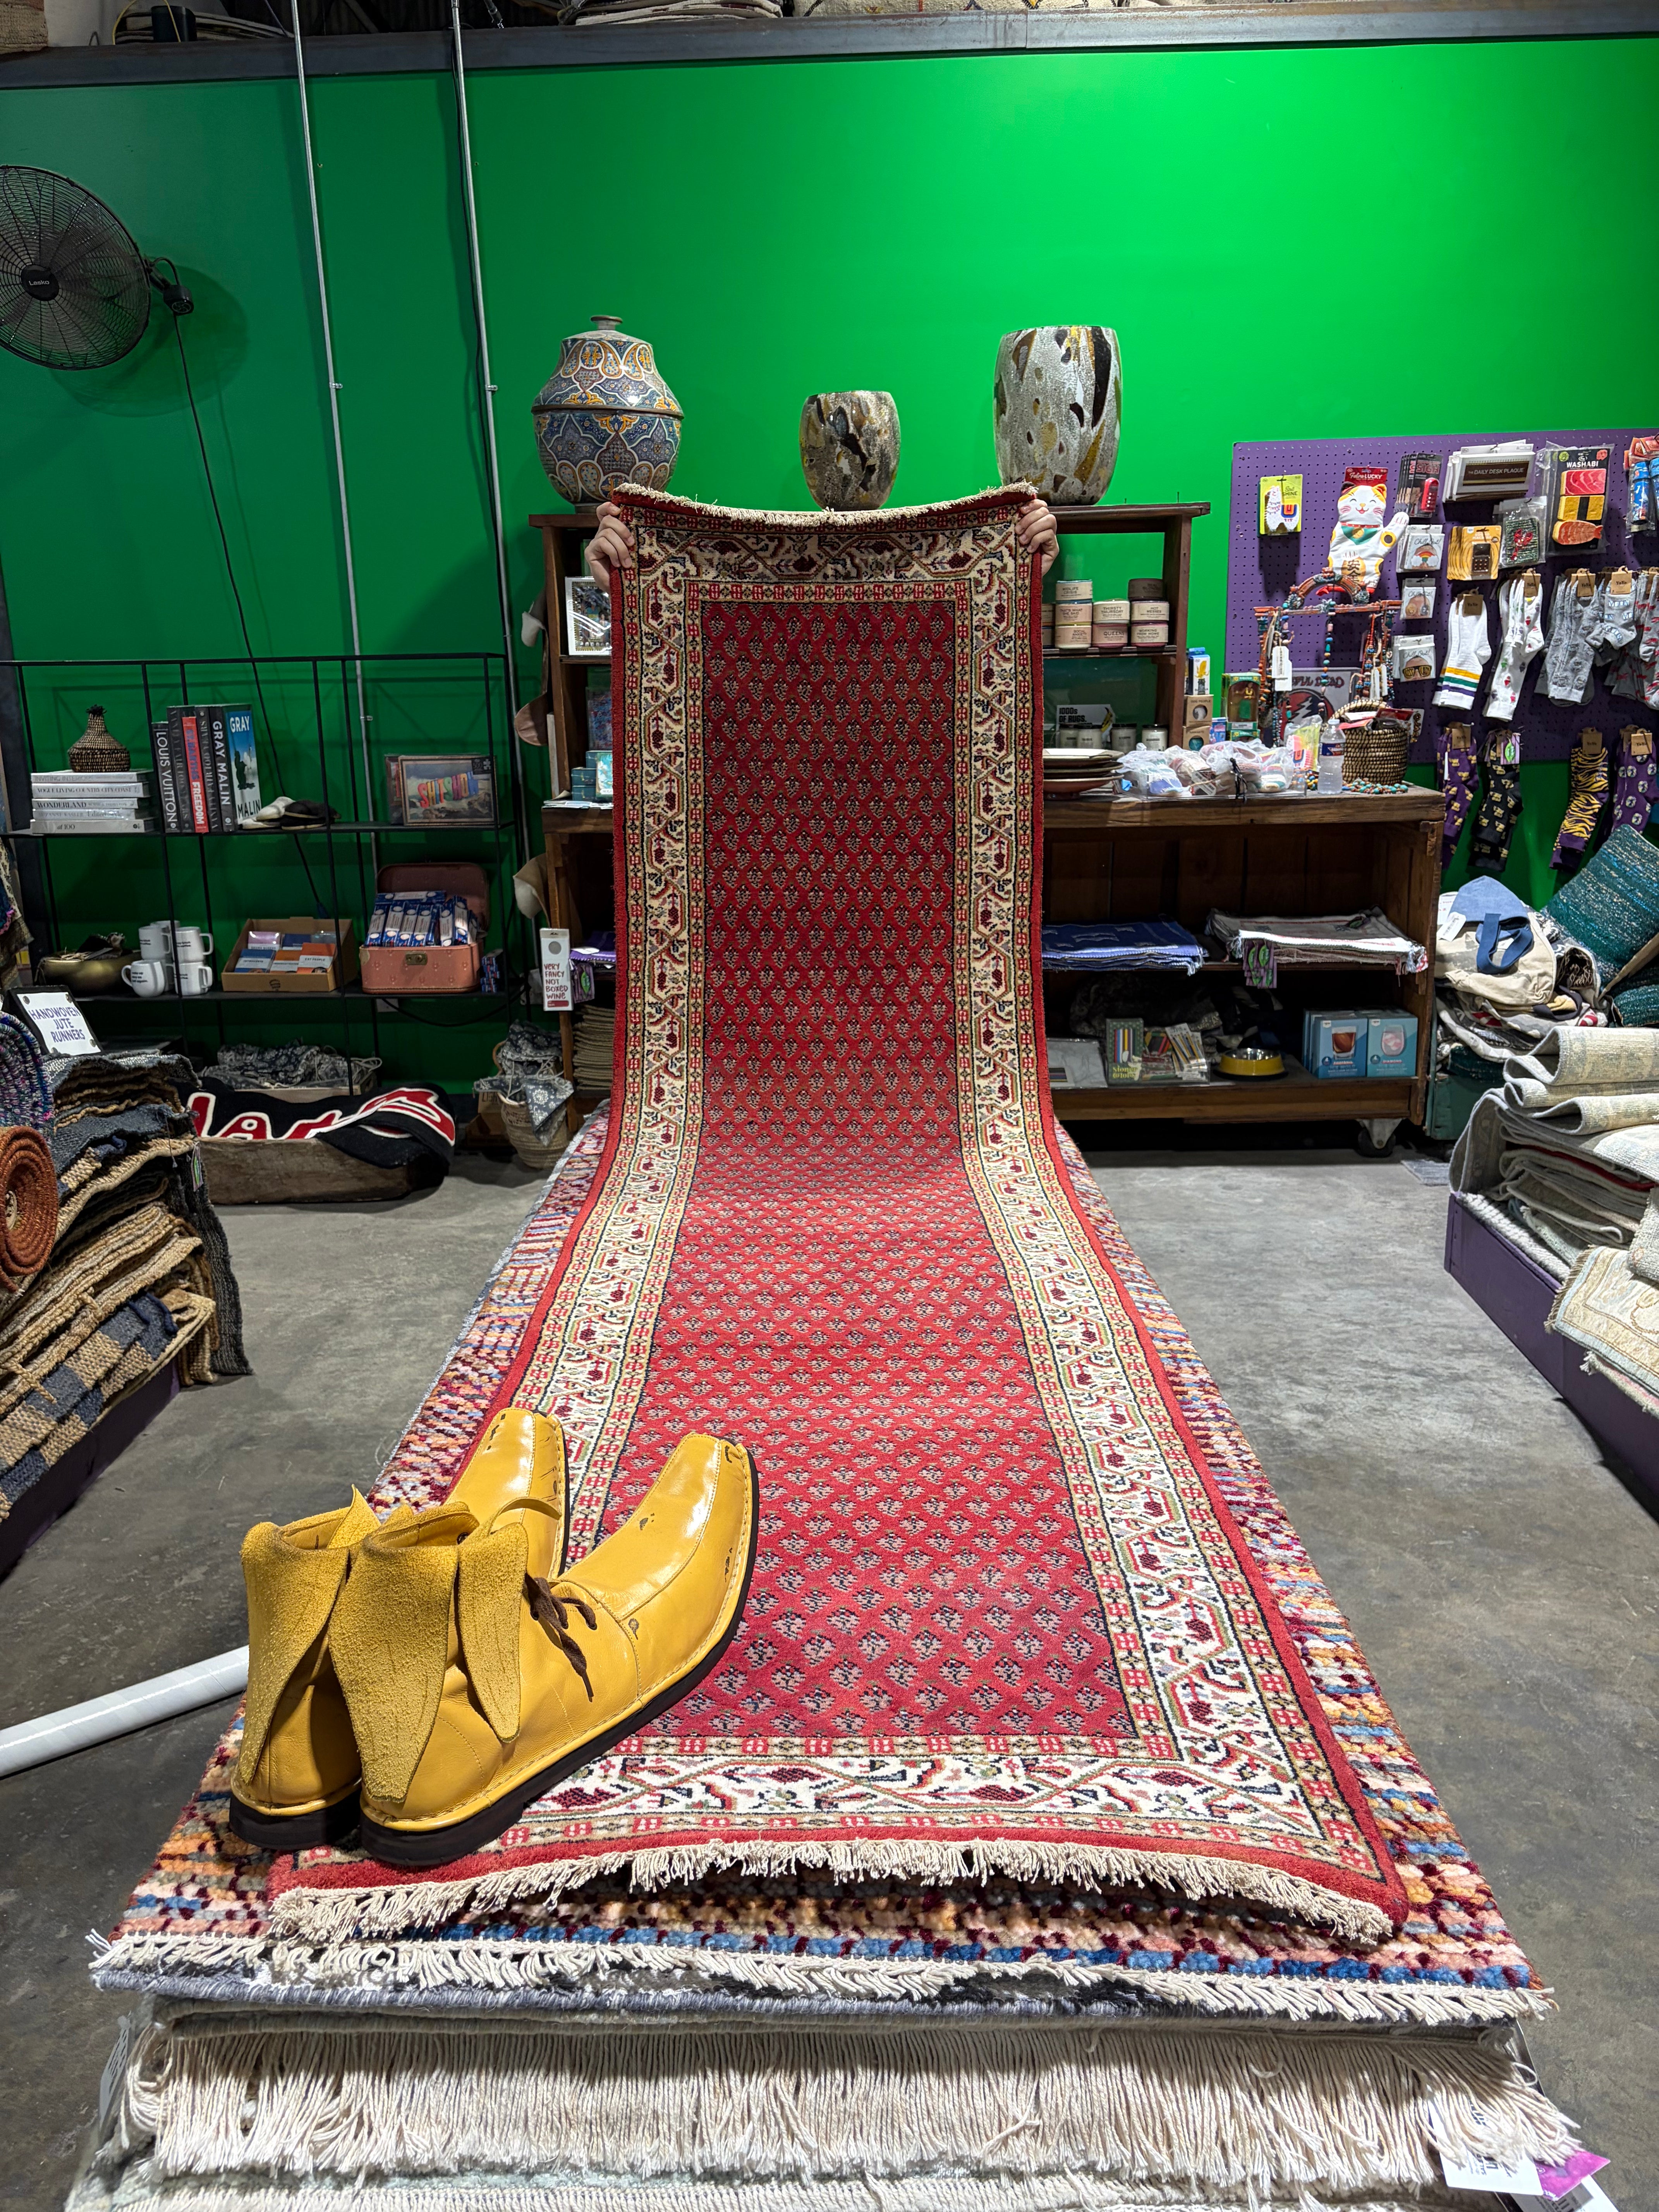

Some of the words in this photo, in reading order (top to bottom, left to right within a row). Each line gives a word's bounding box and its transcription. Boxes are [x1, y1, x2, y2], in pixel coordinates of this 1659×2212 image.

[1315, 676, 1345, 688] DAD
[230, 716, 250, 733] GRAY
[156, 732, 170, 767] LOUIS
[213, 721, 225, 758] GRAY
[161, 769, 178, 822] VUITTON
[217, 763, 231, 805] MALIN
[417, 771, 479, 809] SHITSHOW
[192, 781, 204, 824] FREEDOM
[237, 799, 261, 819] MALIN
[28, 1007, 81, 1020] HANDWOVEN
[53, 1018, 74, 1030] JUTE
[50, 1029, 86, 1042] RUNNERS
